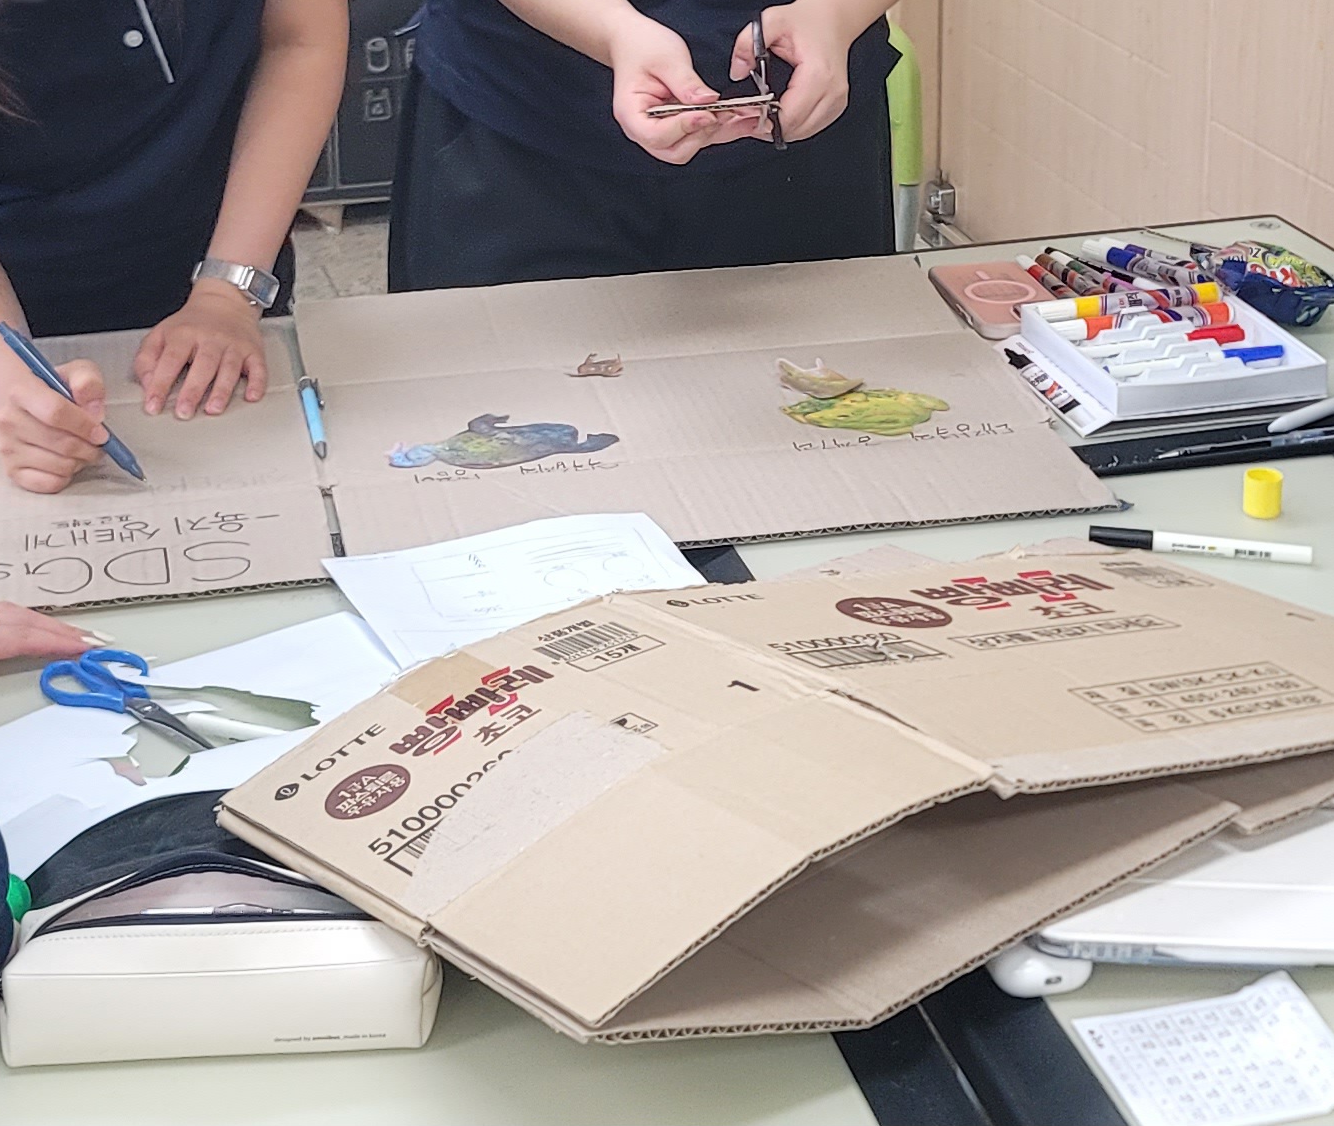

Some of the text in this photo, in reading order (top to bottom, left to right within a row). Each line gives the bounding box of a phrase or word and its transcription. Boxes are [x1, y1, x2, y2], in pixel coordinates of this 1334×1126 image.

[23, 521, 161, 557] 생태계
[690, 594, 765, 607] LOTTE
[593, 643, 642, 663] 15개
[389, 665, 555, 756] 빵빠레
[473, 703, 542, 747] 초코
[300, 723, 387, 782] LOTTE
[347, 776, 406, 817] 우유사용
[368, 750, 513, 857] 510000
